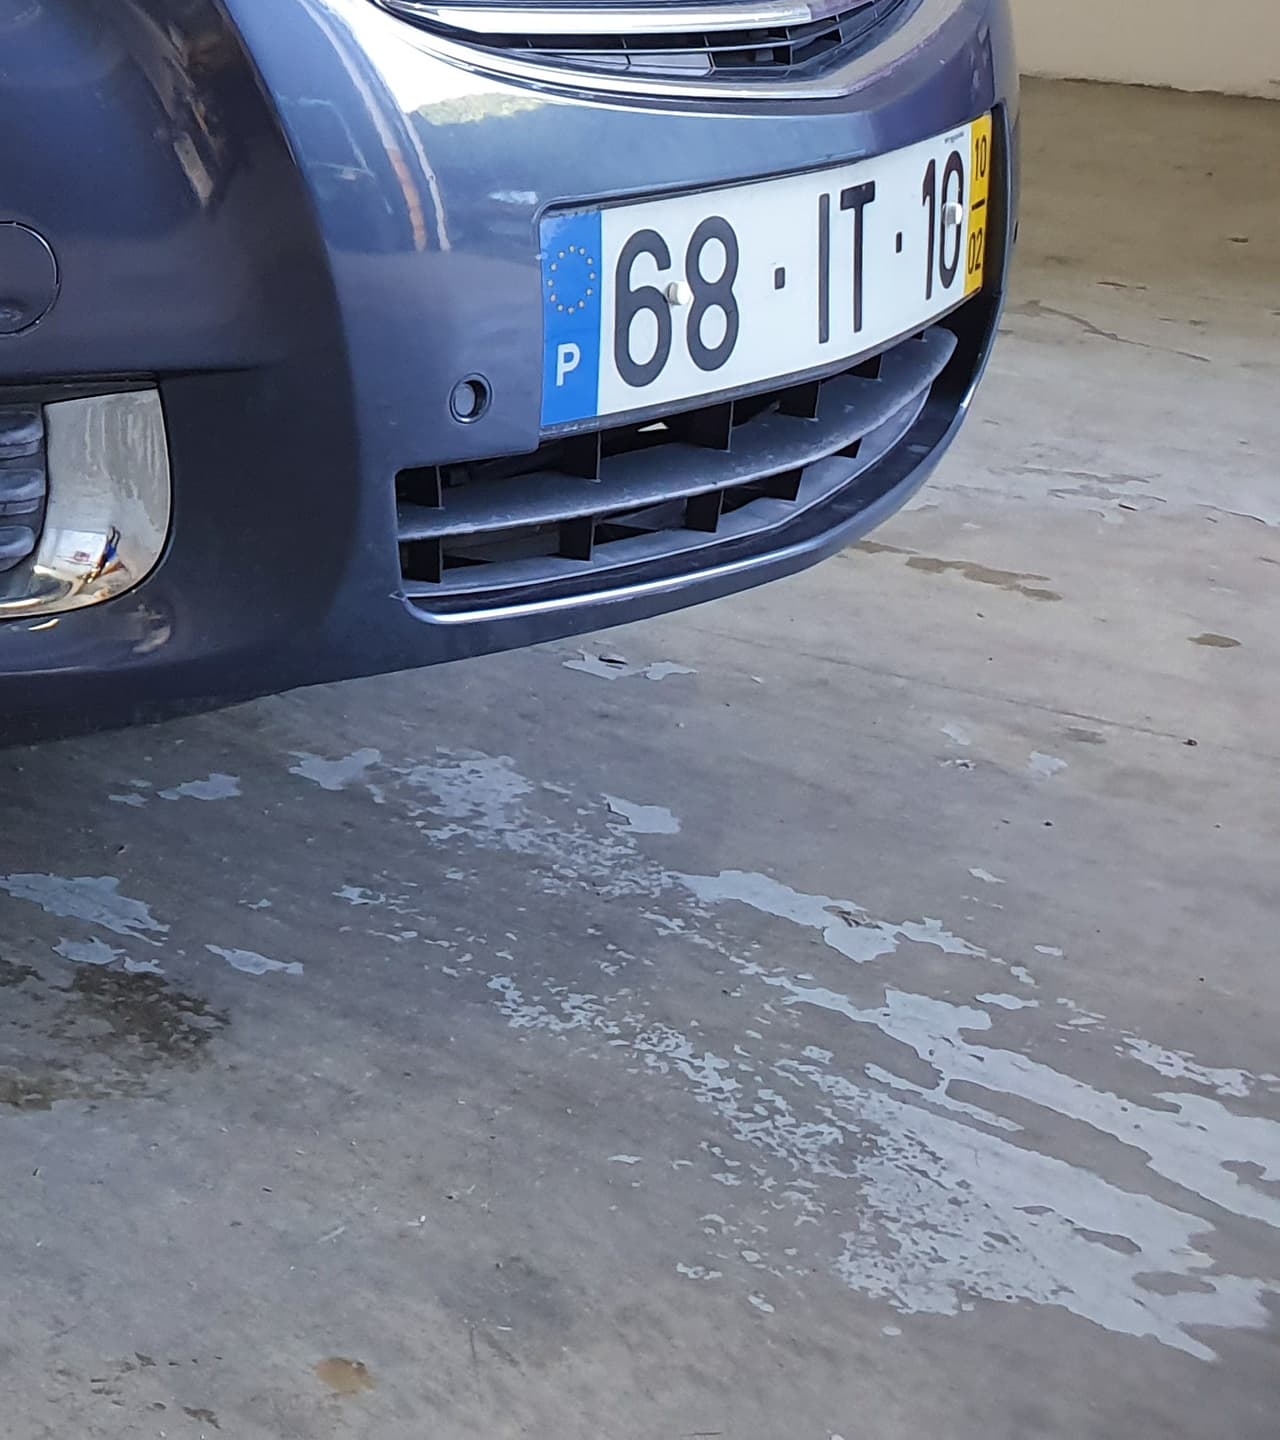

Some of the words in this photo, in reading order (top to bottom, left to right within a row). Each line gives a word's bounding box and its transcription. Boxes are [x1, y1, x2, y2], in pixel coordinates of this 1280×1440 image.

[975, 135, 987, 181] 10
[614, 216, 739, 388] 68
[818, 180, 875, 344] IT
[922, 151, 964, 301] 10
[968, 228, 983, 274] 02
[555, 343, 581, 387] P
